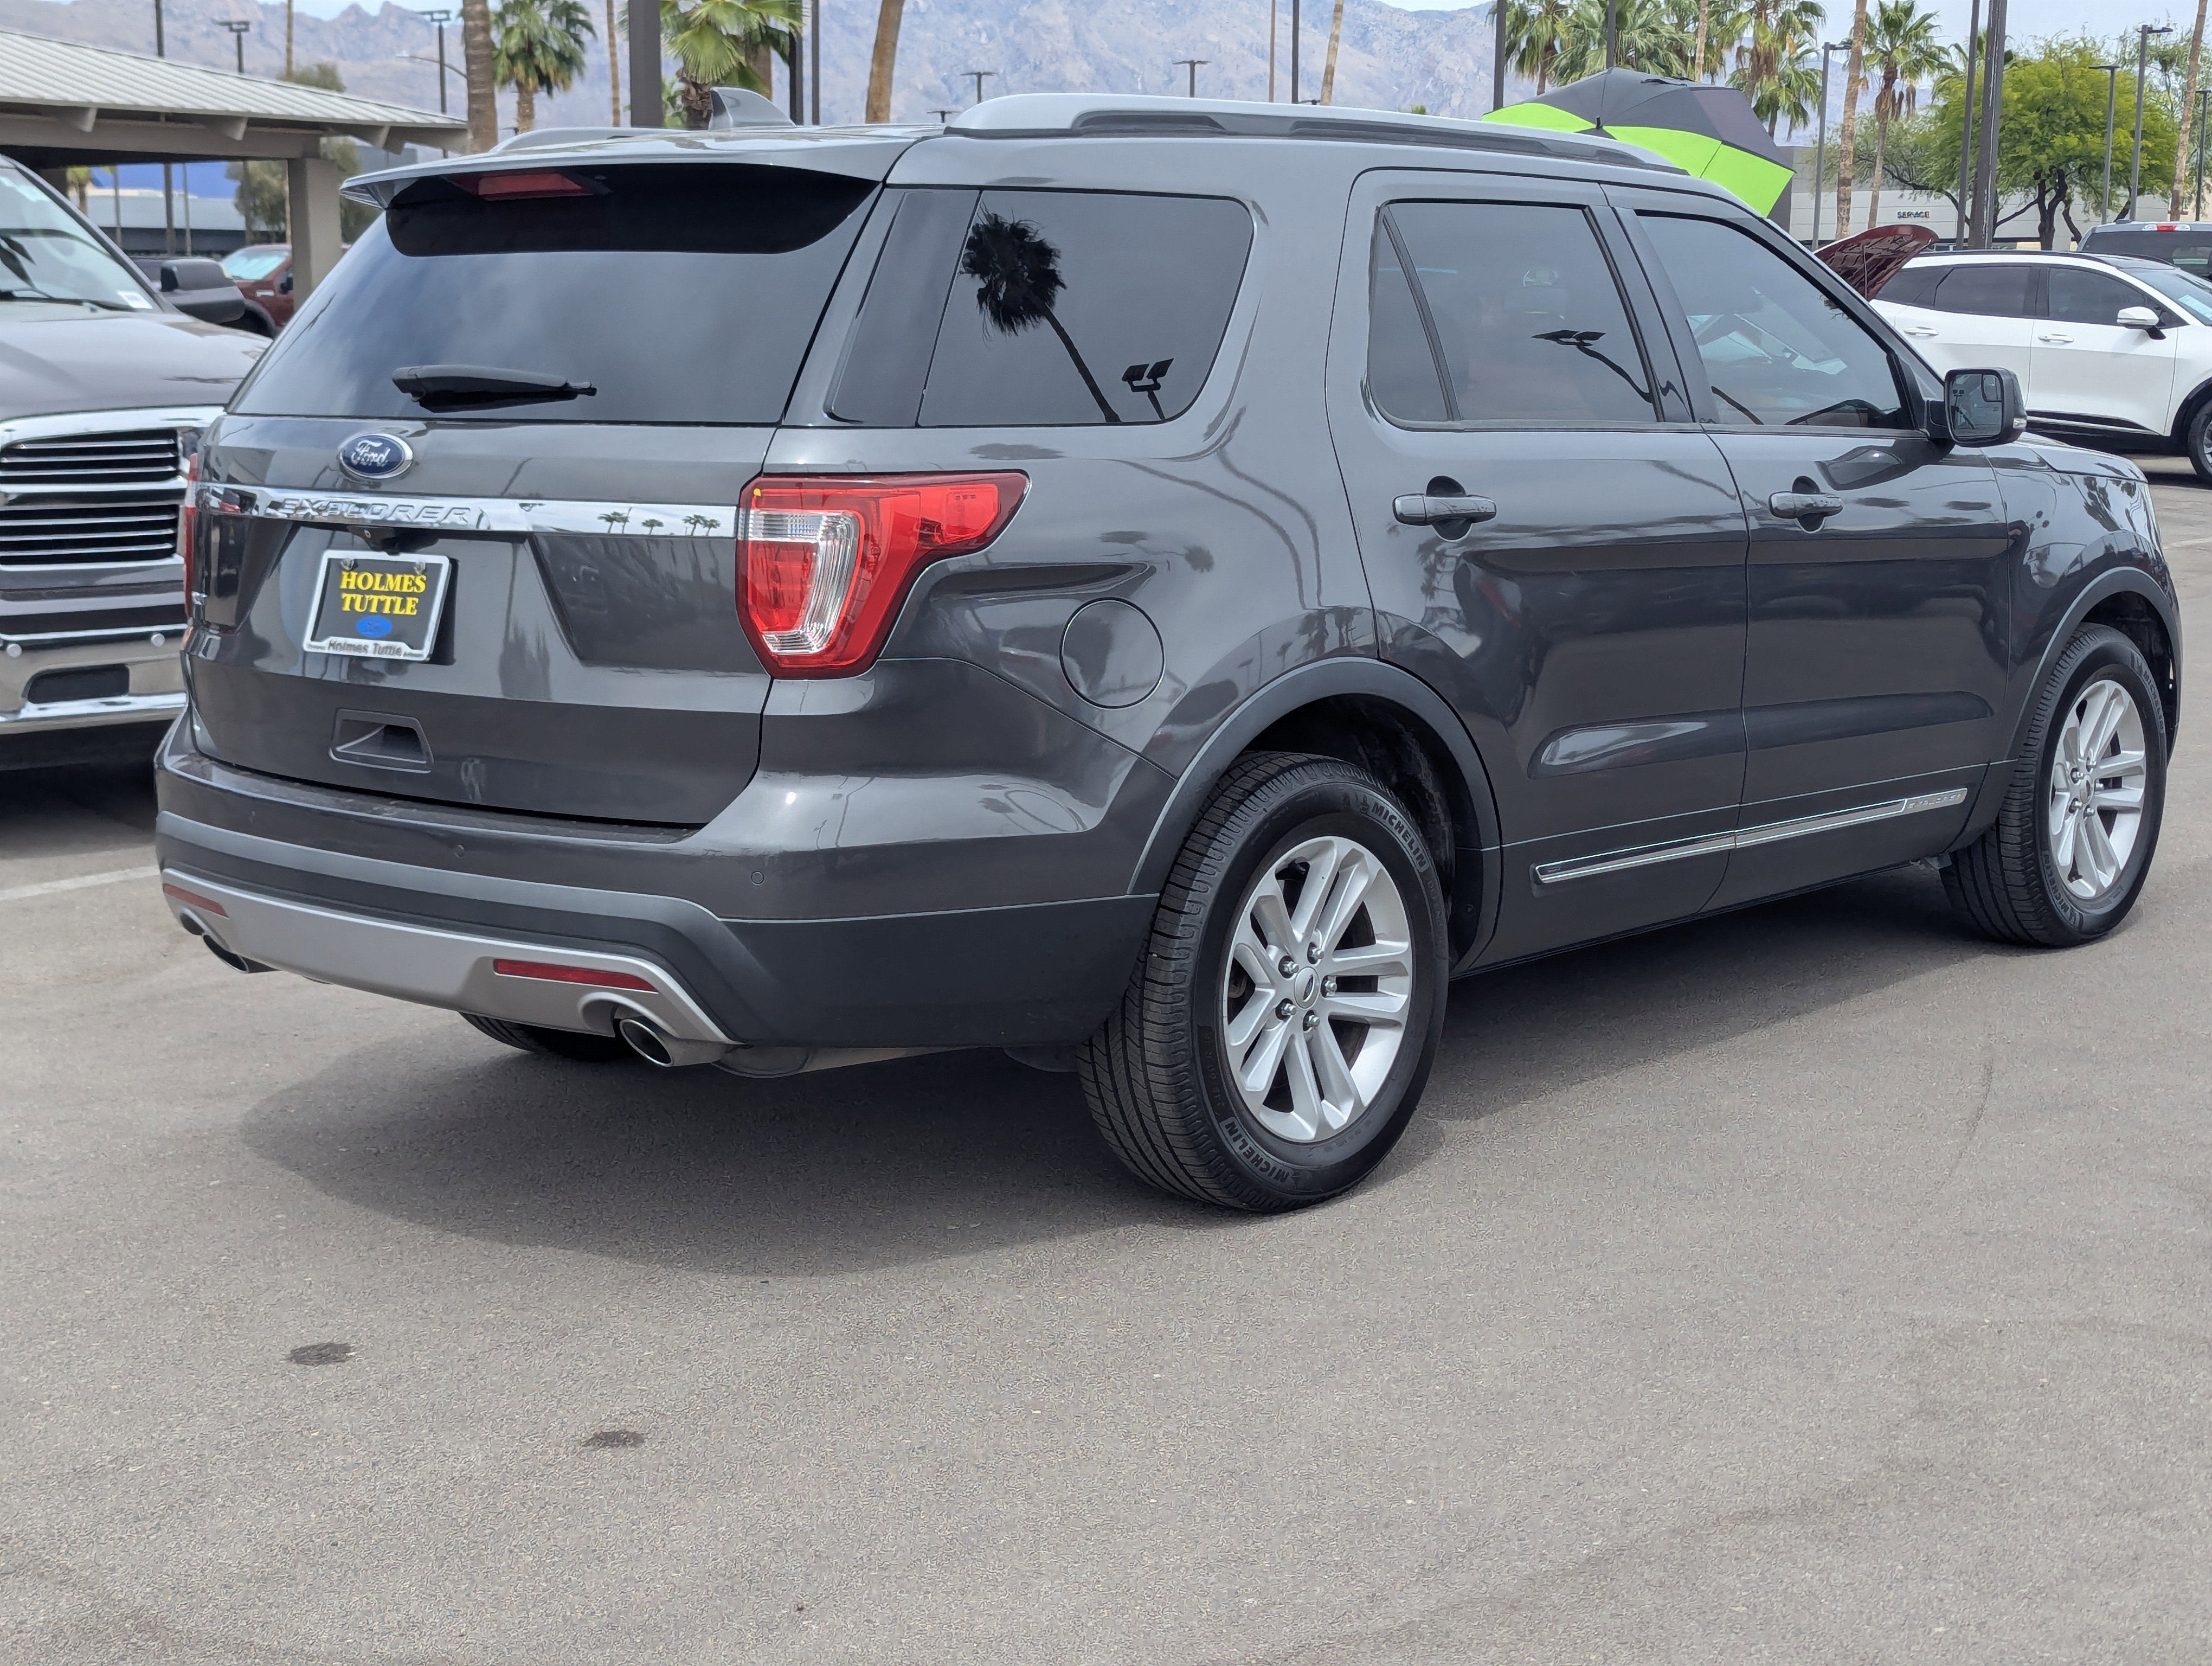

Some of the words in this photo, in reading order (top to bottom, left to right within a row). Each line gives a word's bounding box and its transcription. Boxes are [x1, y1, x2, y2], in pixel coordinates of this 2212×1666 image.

[351, 439, 391, 467] Ford
[279, 497, 471, 525] EXPLORER
[340, 571, 427, 593] HOLMES
[341, 593, 419, 615] TUTTLE
[328, 639, 369, 653] Holmes
[373, 643, 403, 656] Tuttle
[1371, 802, 1427, 868] MICHELIN
[1225, 1120, 1290, 1183] MICHELIN
